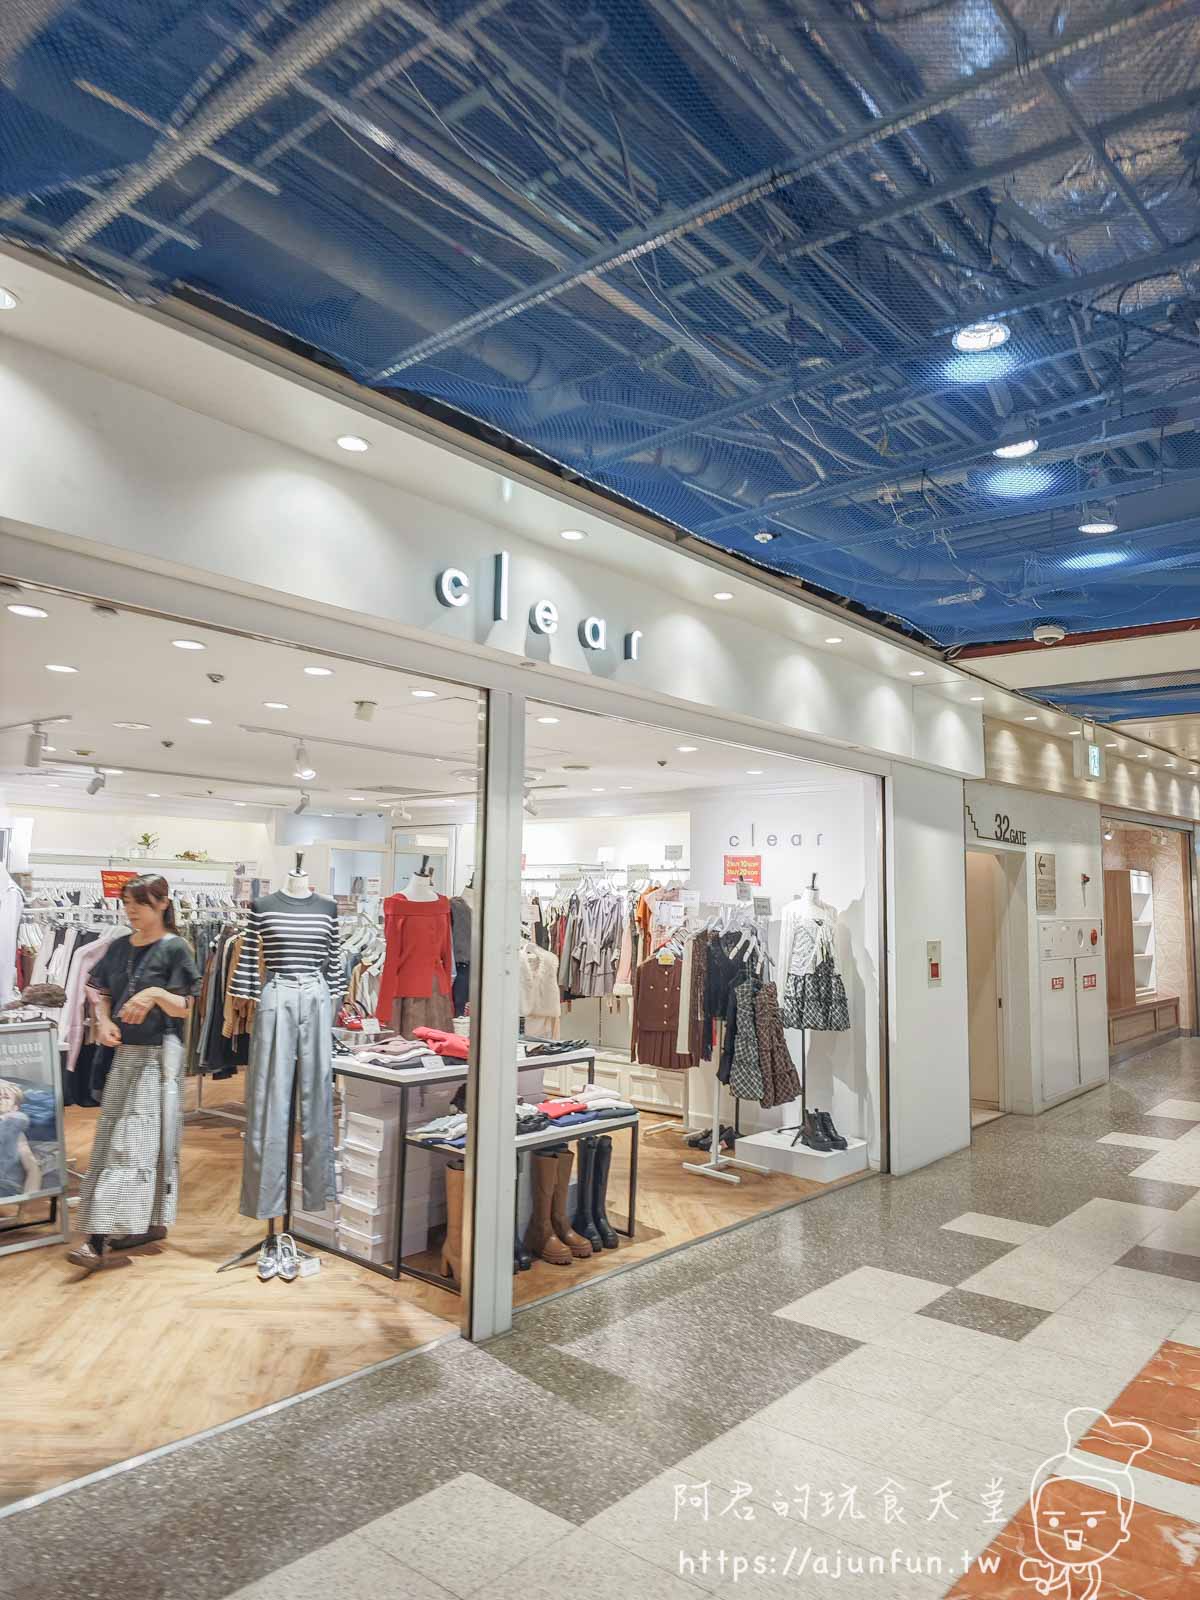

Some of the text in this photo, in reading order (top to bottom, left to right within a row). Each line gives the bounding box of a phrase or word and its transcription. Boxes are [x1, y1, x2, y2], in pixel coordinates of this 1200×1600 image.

[435, 551, 643, 661] clear
[729, 823, 824, 847] clear
[994, 813, 1027, 846] 32 GATE
